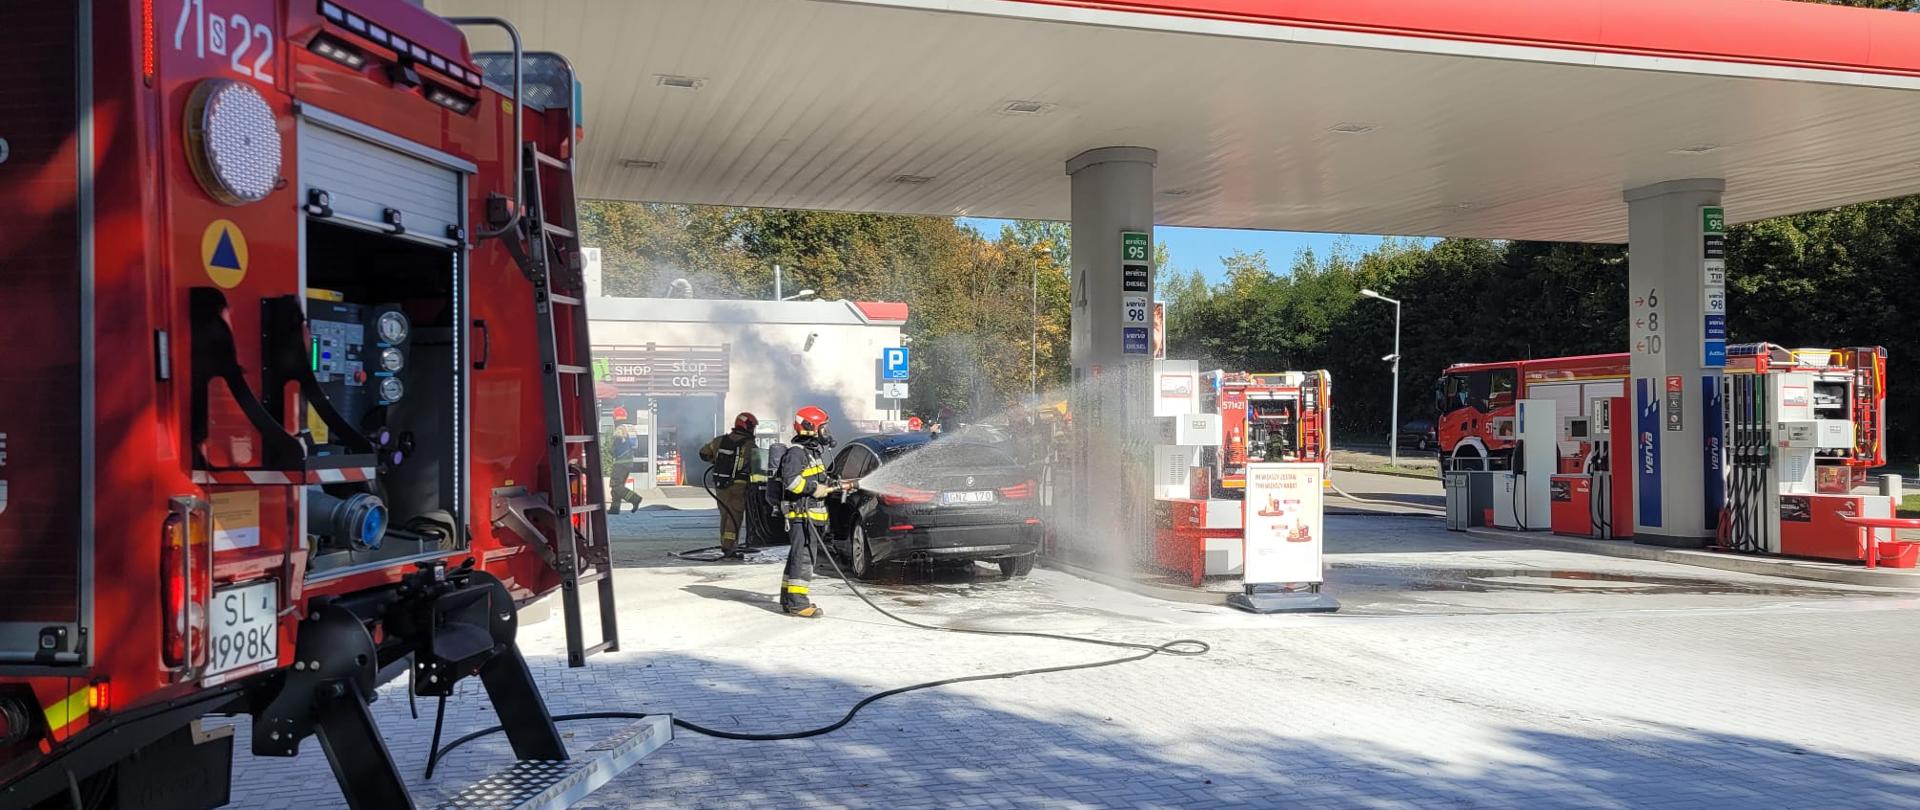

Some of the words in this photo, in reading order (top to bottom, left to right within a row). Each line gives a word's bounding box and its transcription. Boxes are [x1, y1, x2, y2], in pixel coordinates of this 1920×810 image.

[1128, 246, 1145, 259] 95
[1648, 287, 1658, 308] 6
[1128, 309, 1145, 322] 98
[1648, 311, 1658, 332] 8
[1645, 334, 1662, 355] 10
[615, 365, 652, 376] SHOP
[672, 360, 707, 376] stop
[888, 350, 904, 371] P
[672, 374, 708, 388] cafe
[1645, 431, 1654, 475] verva
[1711, 437, 1719, 470] verva
[224, 591, 255, 627] SL
